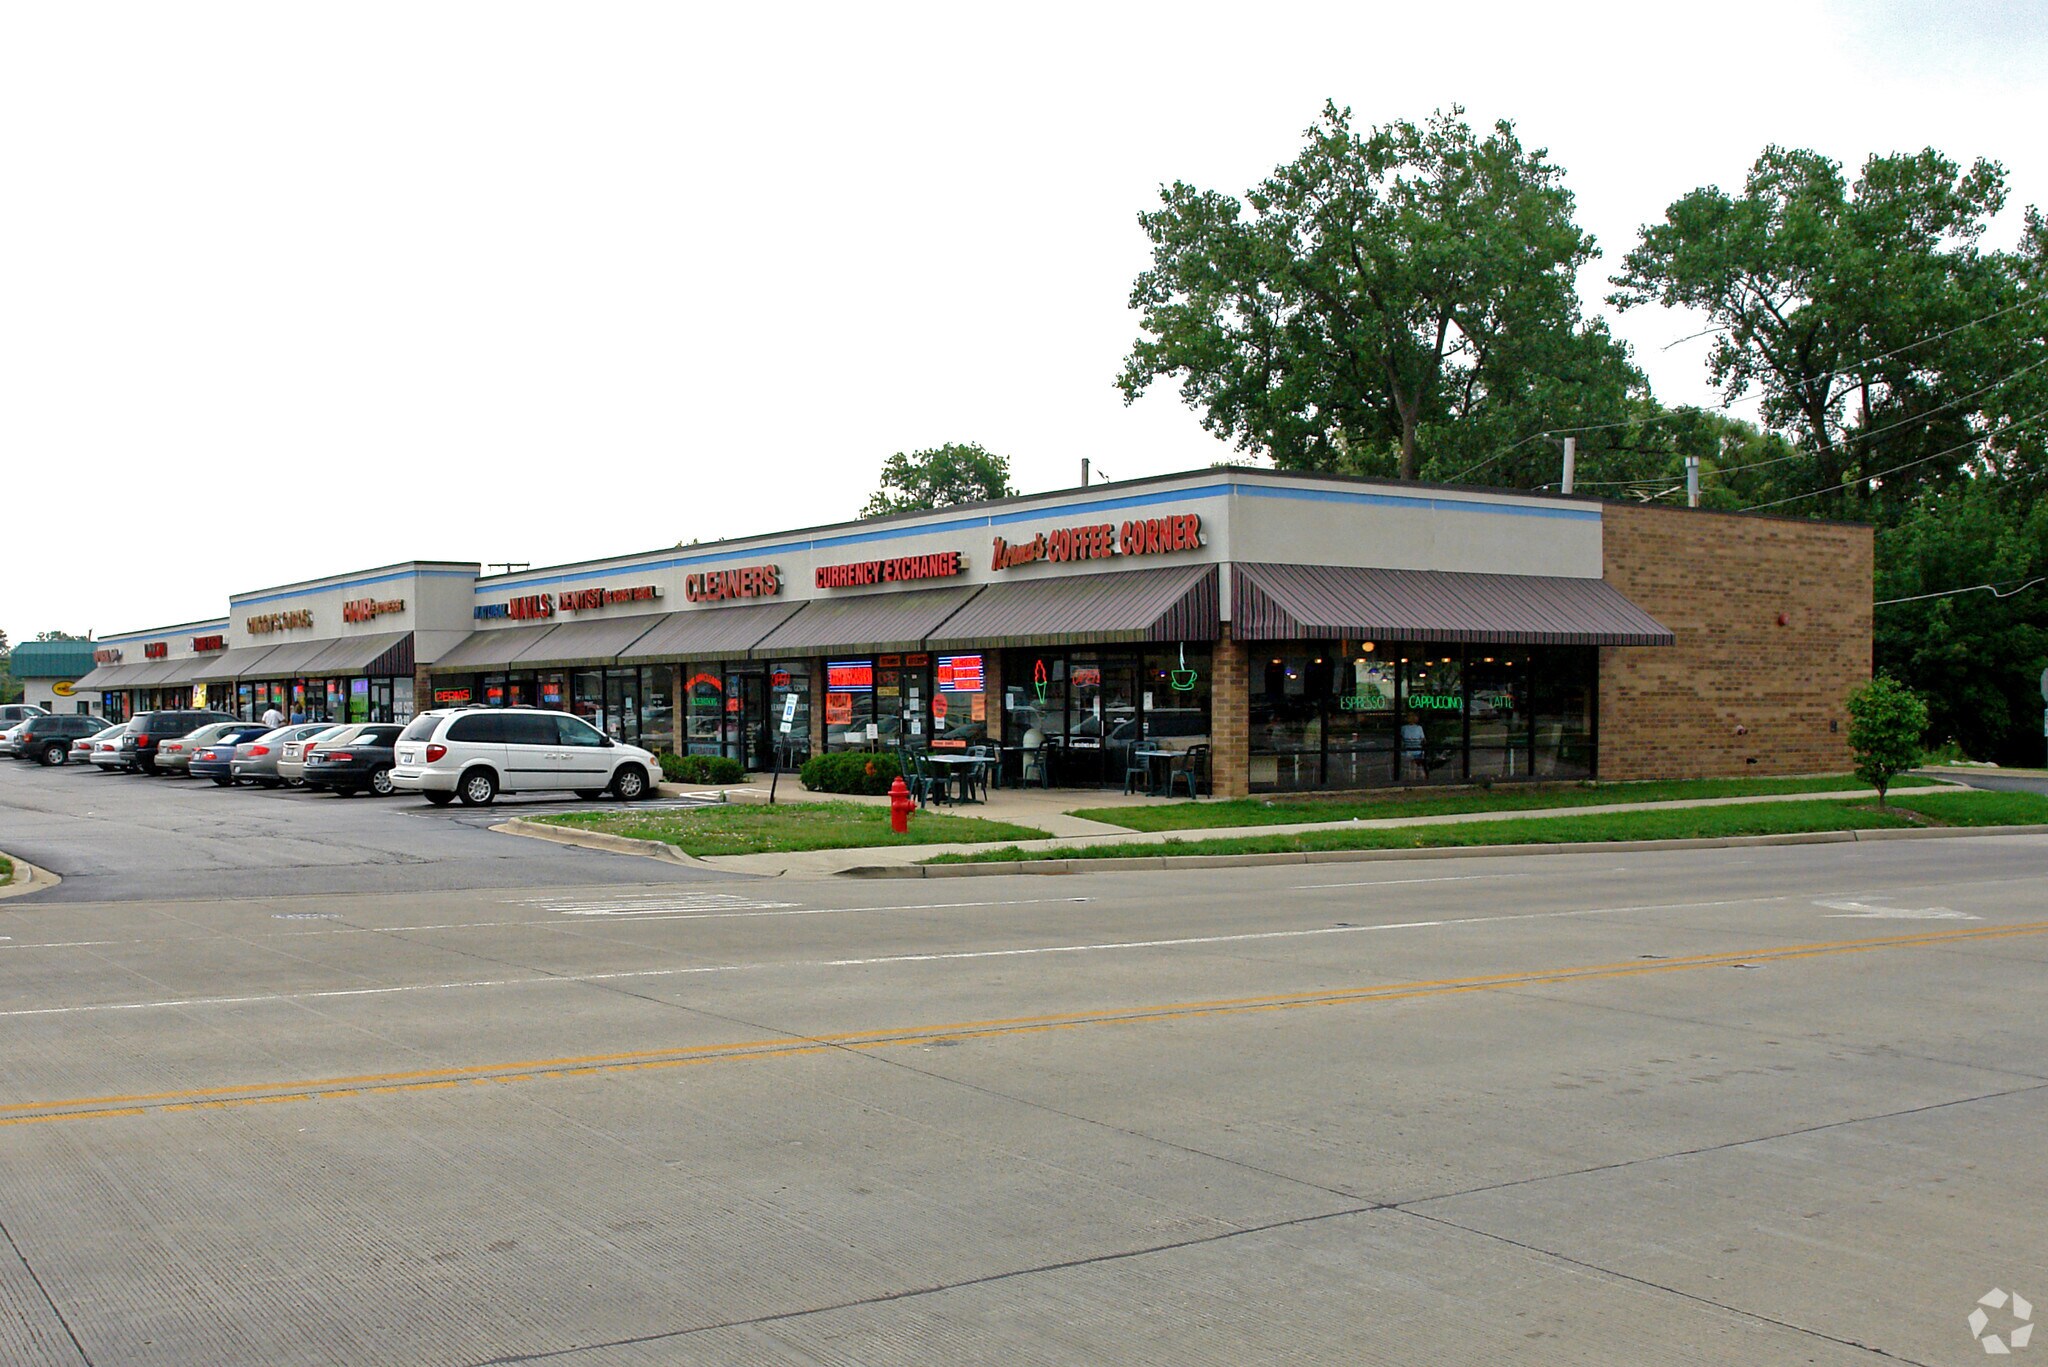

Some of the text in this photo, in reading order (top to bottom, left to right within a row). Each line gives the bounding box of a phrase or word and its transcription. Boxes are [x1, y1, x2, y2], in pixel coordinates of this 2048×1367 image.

[1047, 523, 1113, 563] COFFEE
[1119, 513, 1200, 556] CORNER
[685, 564, 779, 602] CLEANERS
[815, 551, 960, 589] CURRENCY EXCHANGE
[509, 593, 551, 621] NAILS
[558, 588, 603, 611] DENTIST
[1340, 696, 1386, 710] ESPRESSO
